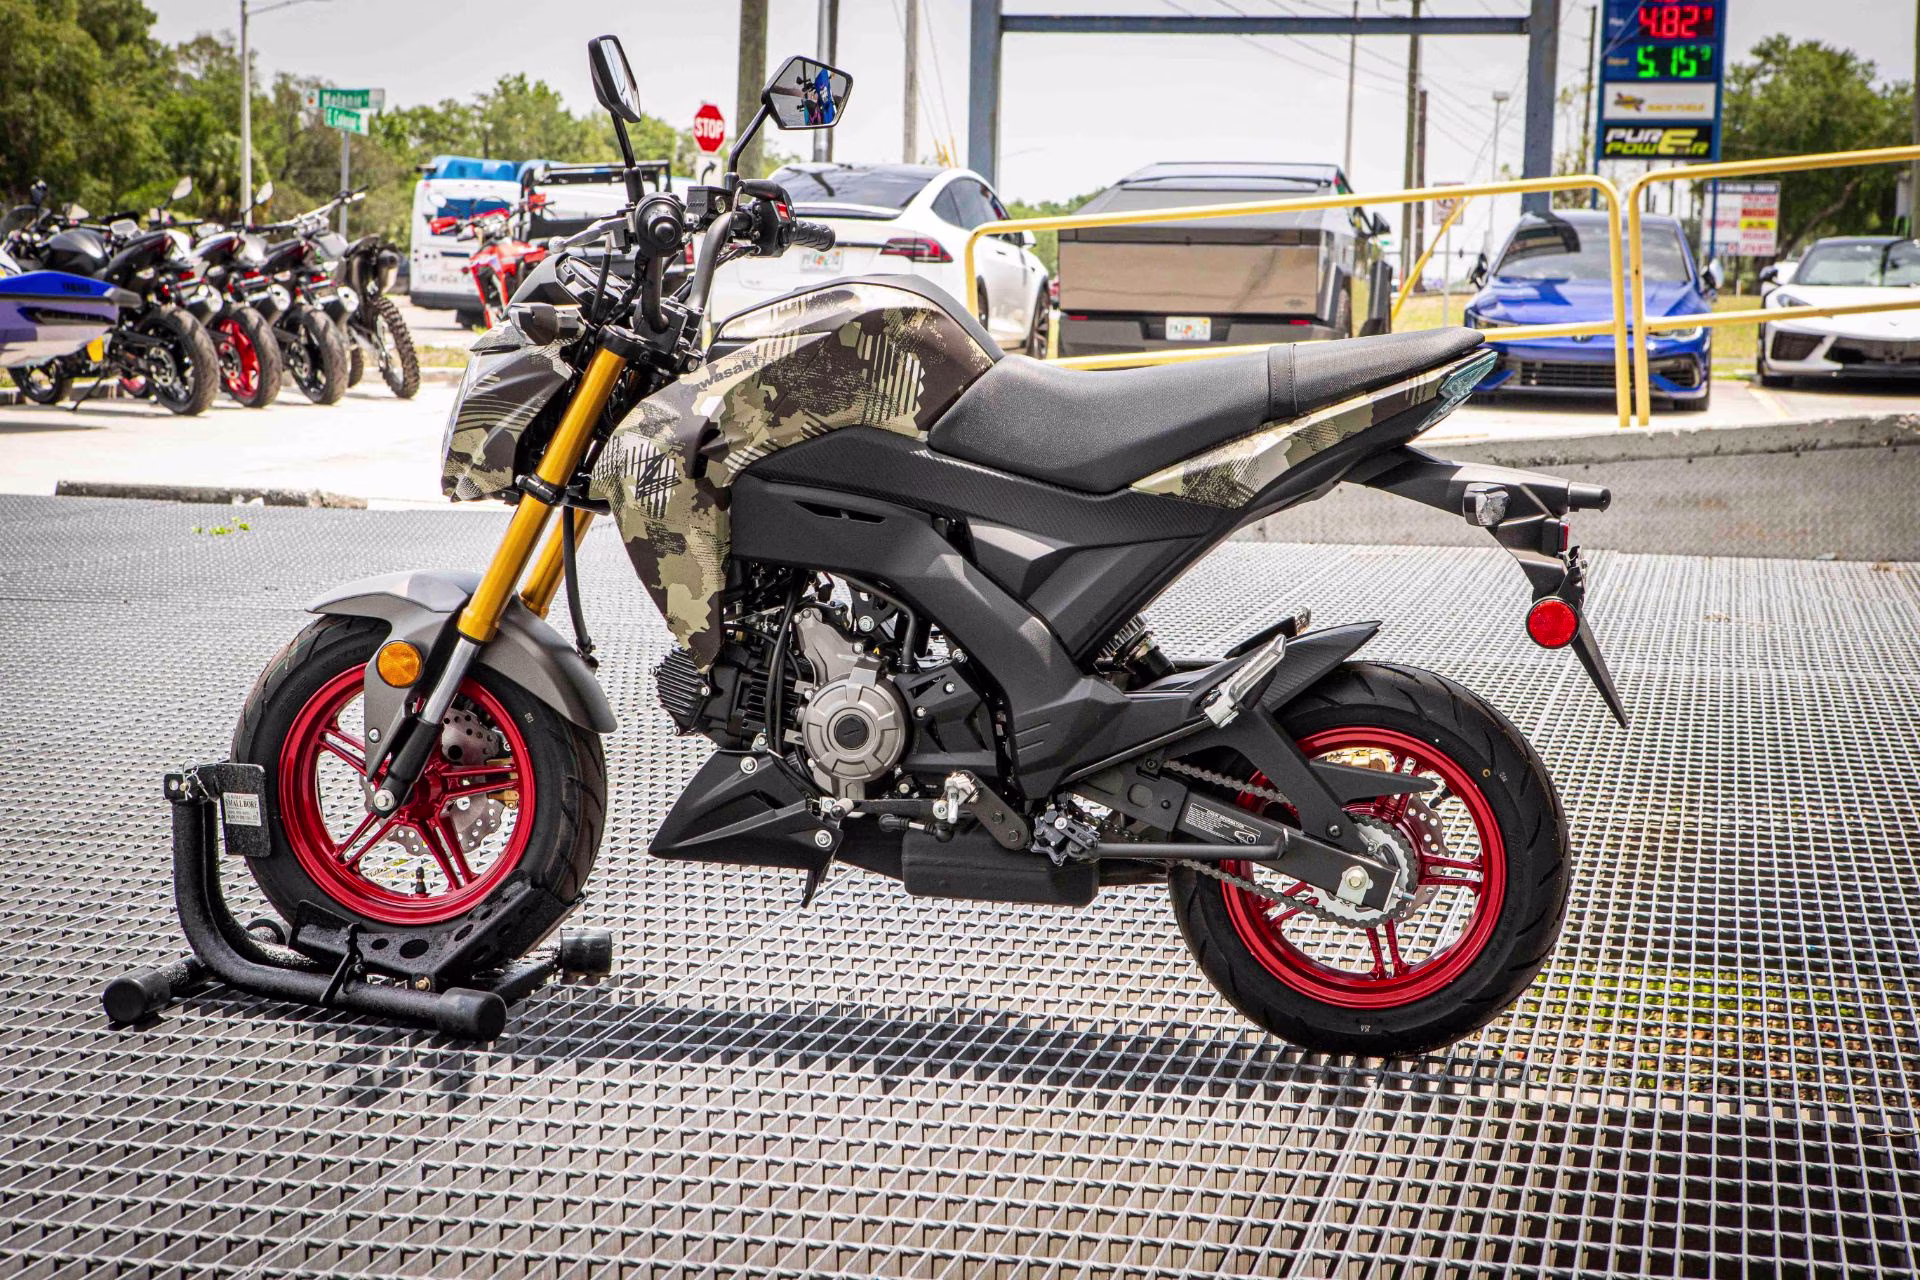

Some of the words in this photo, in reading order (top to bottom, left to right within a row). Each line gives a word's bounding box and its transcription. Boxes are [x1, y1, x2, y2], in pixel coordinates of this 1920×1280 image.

[694, 117, 724, 139] STOP
[225, 799, 243, 808] SMALL
[243, 800, 258, 809] BORE
